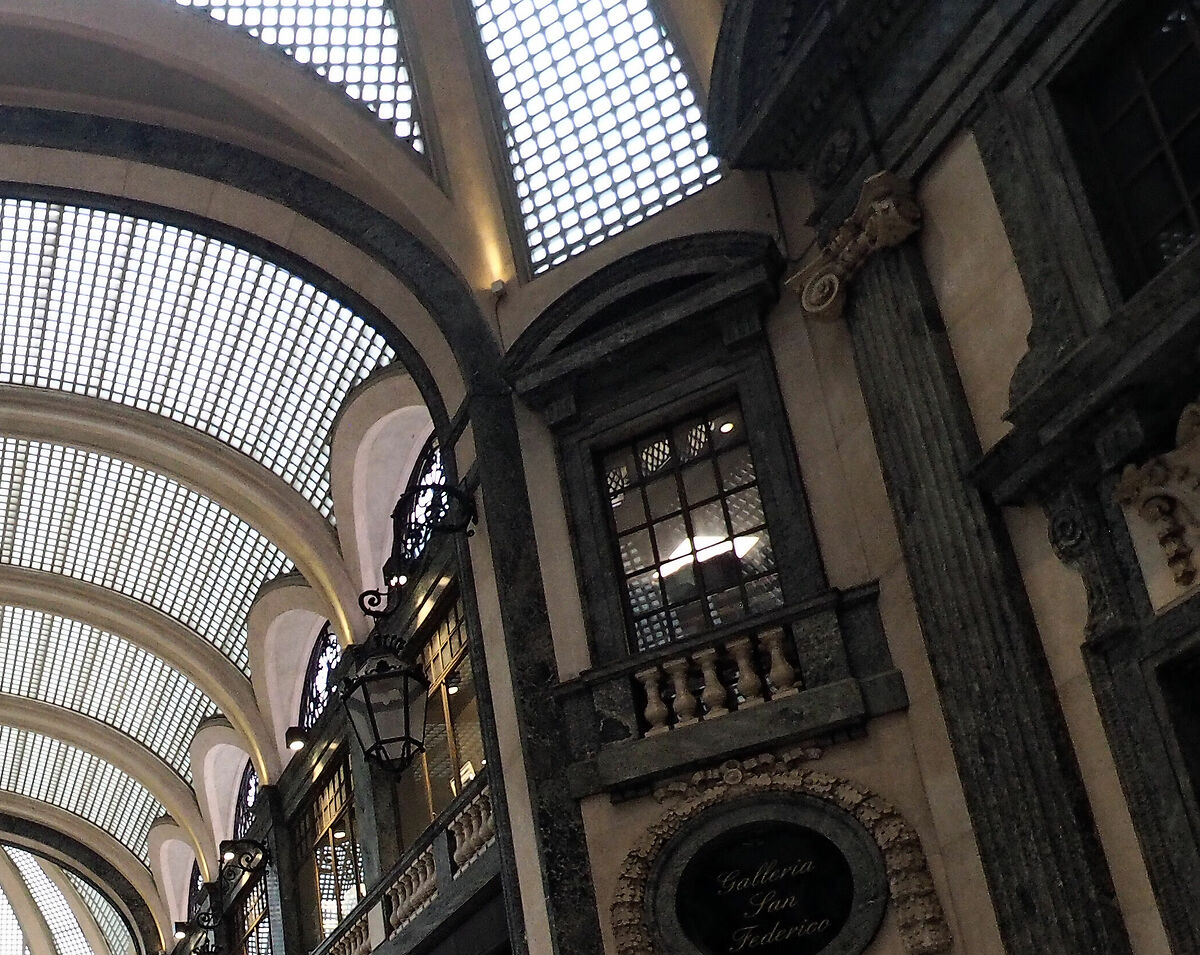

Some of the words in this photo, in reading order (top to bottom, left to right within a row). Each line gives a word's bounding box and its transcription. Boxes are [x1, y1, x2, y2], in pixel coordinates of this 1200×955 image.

[716, 858, 816, 895] Galleria
[743, 890, 799, 918] San
[728, 918, 831, 953] Federico
